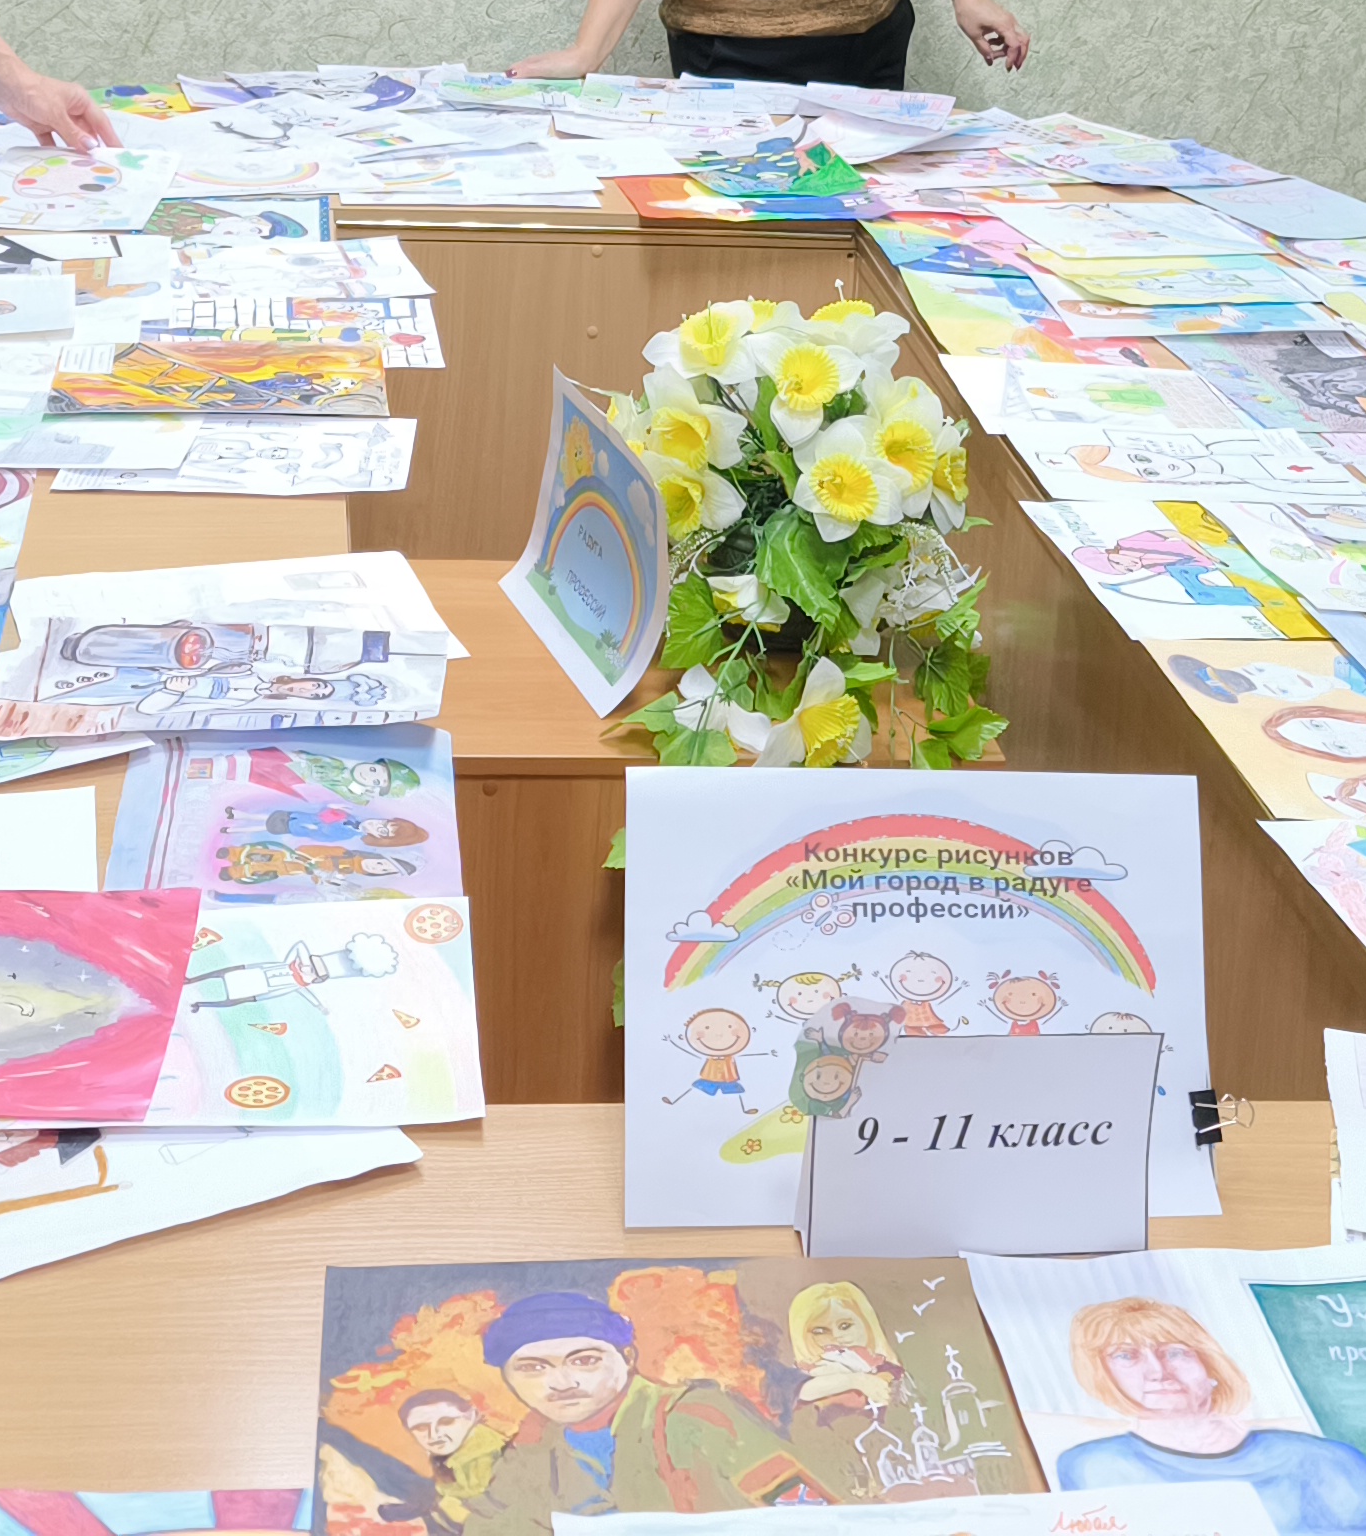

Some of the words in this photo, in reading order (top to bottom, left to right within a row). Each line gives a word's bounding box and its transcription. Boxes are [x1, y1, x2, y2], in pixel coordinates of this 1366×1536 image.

[577, 524, 604, 560] РАДУГА
[565, 569, 607, 622] ПРОФЕССИЙ
[803, 842, 926, 869] Конкурс
[937, 844, 1073, 871] рисунков
[785, 869, 864, 892] «Мой
[874, 871, 959, 896] город
[969, 875, 985, 891] в
[993, 873, 1092, 897] радуге
[851, 896, 1030, 923] профессий»
[855, 1115, 880, 1155] 9
[924, 1113, 974, 1152] 11
[988, 1118, 1113, 1149] класс
